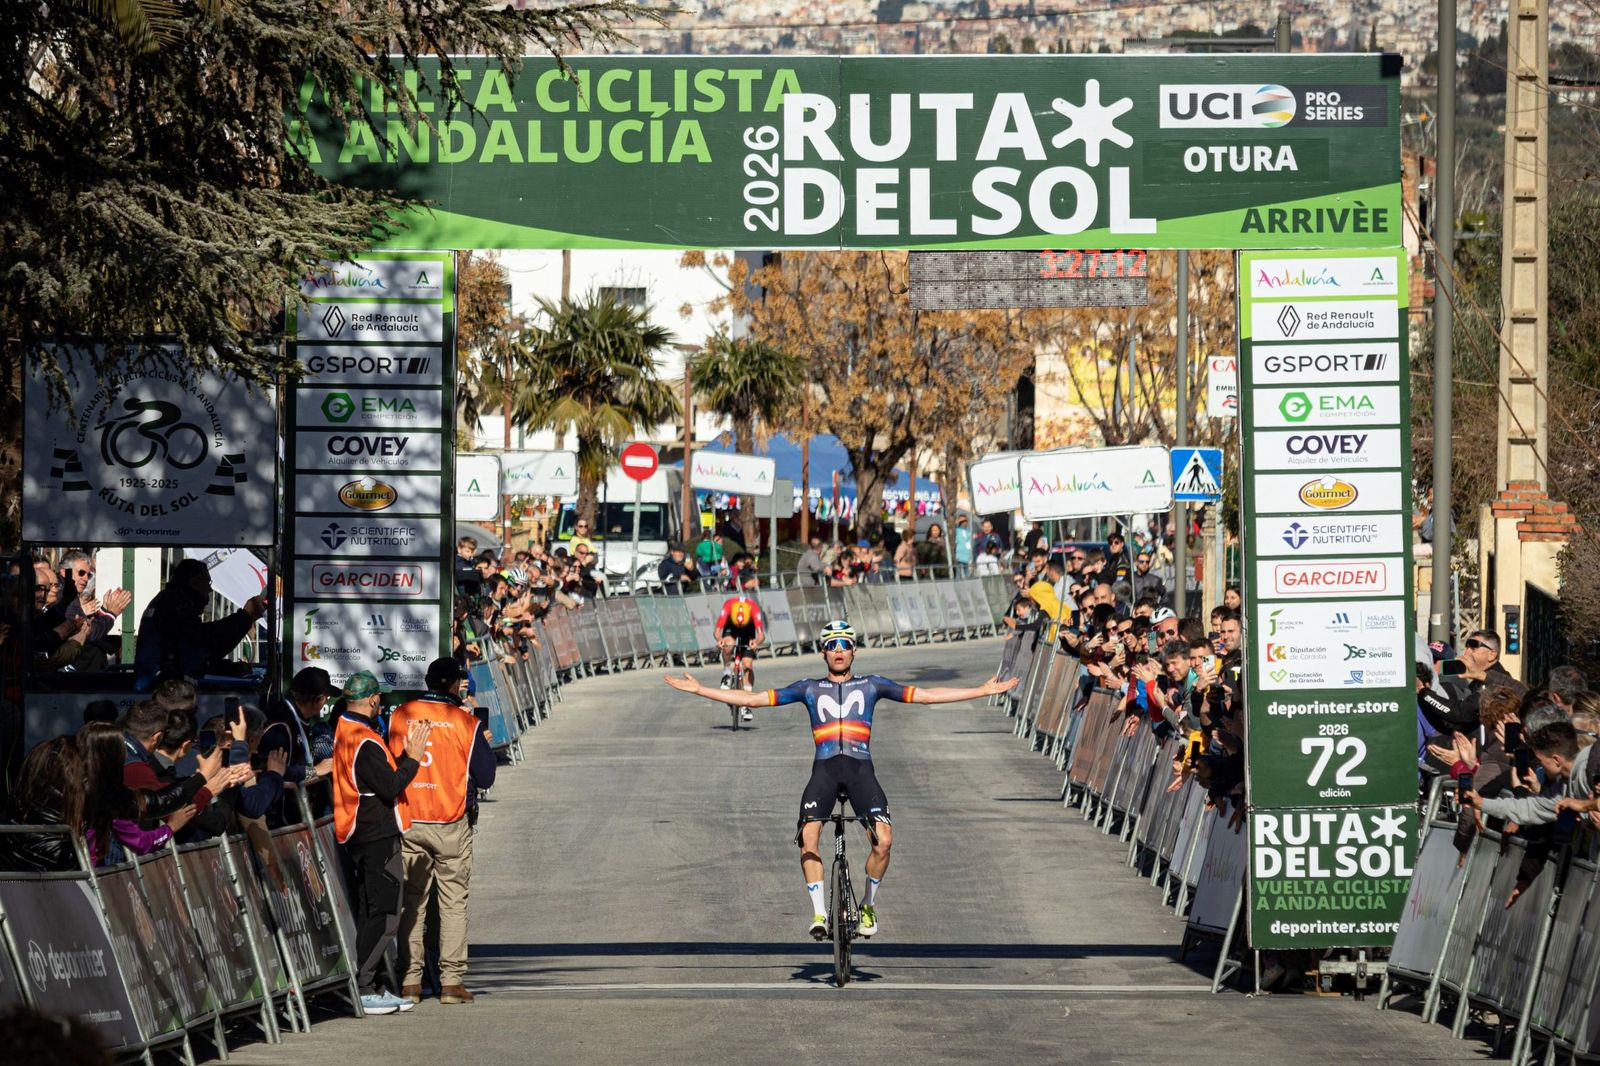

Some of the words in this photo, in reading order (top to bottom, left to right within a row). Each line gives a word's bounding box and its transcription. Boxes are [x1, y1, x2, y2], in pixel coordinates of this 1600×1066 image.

[535, 69, 808, 113] CICLISTA
[1305, 92, 1341, 106] PRO
[1169, 93, 1242, 120] UCI
[1305, 106, 1364, 120] SERIES
[784, 92, 1047, 161] RUTA
[338, 108, 712, 163] ANDALUCÍA
[1183, 145, 1298, 173] OTURA
[743, 125, 780, 233] 2026
[784, 167, 959, 235] DEL
[971, 166, 1156, 236] SOL
[1240, 201, 1388, 233] ARRIVÈE
[1040, 249, 1147, 278] 3:27:12
[1257, 267, 1342, 288] Andalucía
[351, 313, 372, 322] Red
[375, 313, 418, 323] Renault
[1306, 312, 1327, 320] Red
[1330, 310, 1374, 320] Renault
[351, 323, 364, 331] de
[366, 322, 418, 332] Andalucía
[1306, 320, 1319, 330] de
[1321, 320, 1374, 330] Andalucía
[308, 356, 407, 374] GSPORT
[1264, 354, 1363, 373] GSPORT
[361, 397, 416, 412] EMA
[1319, 395, 1374, 410] EMA
[327, 436, 409, 456] COVEY
[1286, 434, 1368, 455] COVEY
[328, 457, 357, 466] Alquiler
[359, 457, 369, 465] de
[1287, 456, 1317, 465] Alquiler
[120, 478, 178, 489] 1925-2025
[1028, 473, 1112, 496] Andalucía
[98, 487, 135, 515] RUTA
[140, 503, 168, 516] DEL
[170, 491, 199, 512] SOL
[344, 490, 391, 500] Gourmet
[1305, 489, 1351, 499] Gourmet
[351, 527, 416, 536] SCIENTIFFIC
[1312, 524, 1377, 534] SCIENTIFFIC
[320, 572, 414, 587] GARCIDEN
[1283, 570, 1377, 585] GARCIDEN
[324, 646, 361, 654] Diputación
[1290, 646, 1327, 654] Diputación
[1268, 701, 1399, 718] deporinter.store
[1318, 724, 1349, 735] 2026
[1301, 737, 1367, 787] 72
[1319, 788, 1351, 798] edición
[1254, 813, 1368, 845] RUTA
[1255, 847, 1330, 878] DEL
[1335, 845, 1413, 878] SOL
[1256, 880, 1328, 895] VUELTA
[1256, 896, 1270, 910] A
[1274, 891, 1387, 910] ANDALUCÍA
[1271, 920, 1400, 937] deporinter.store
[48, 943, 107, 989] deporinter
